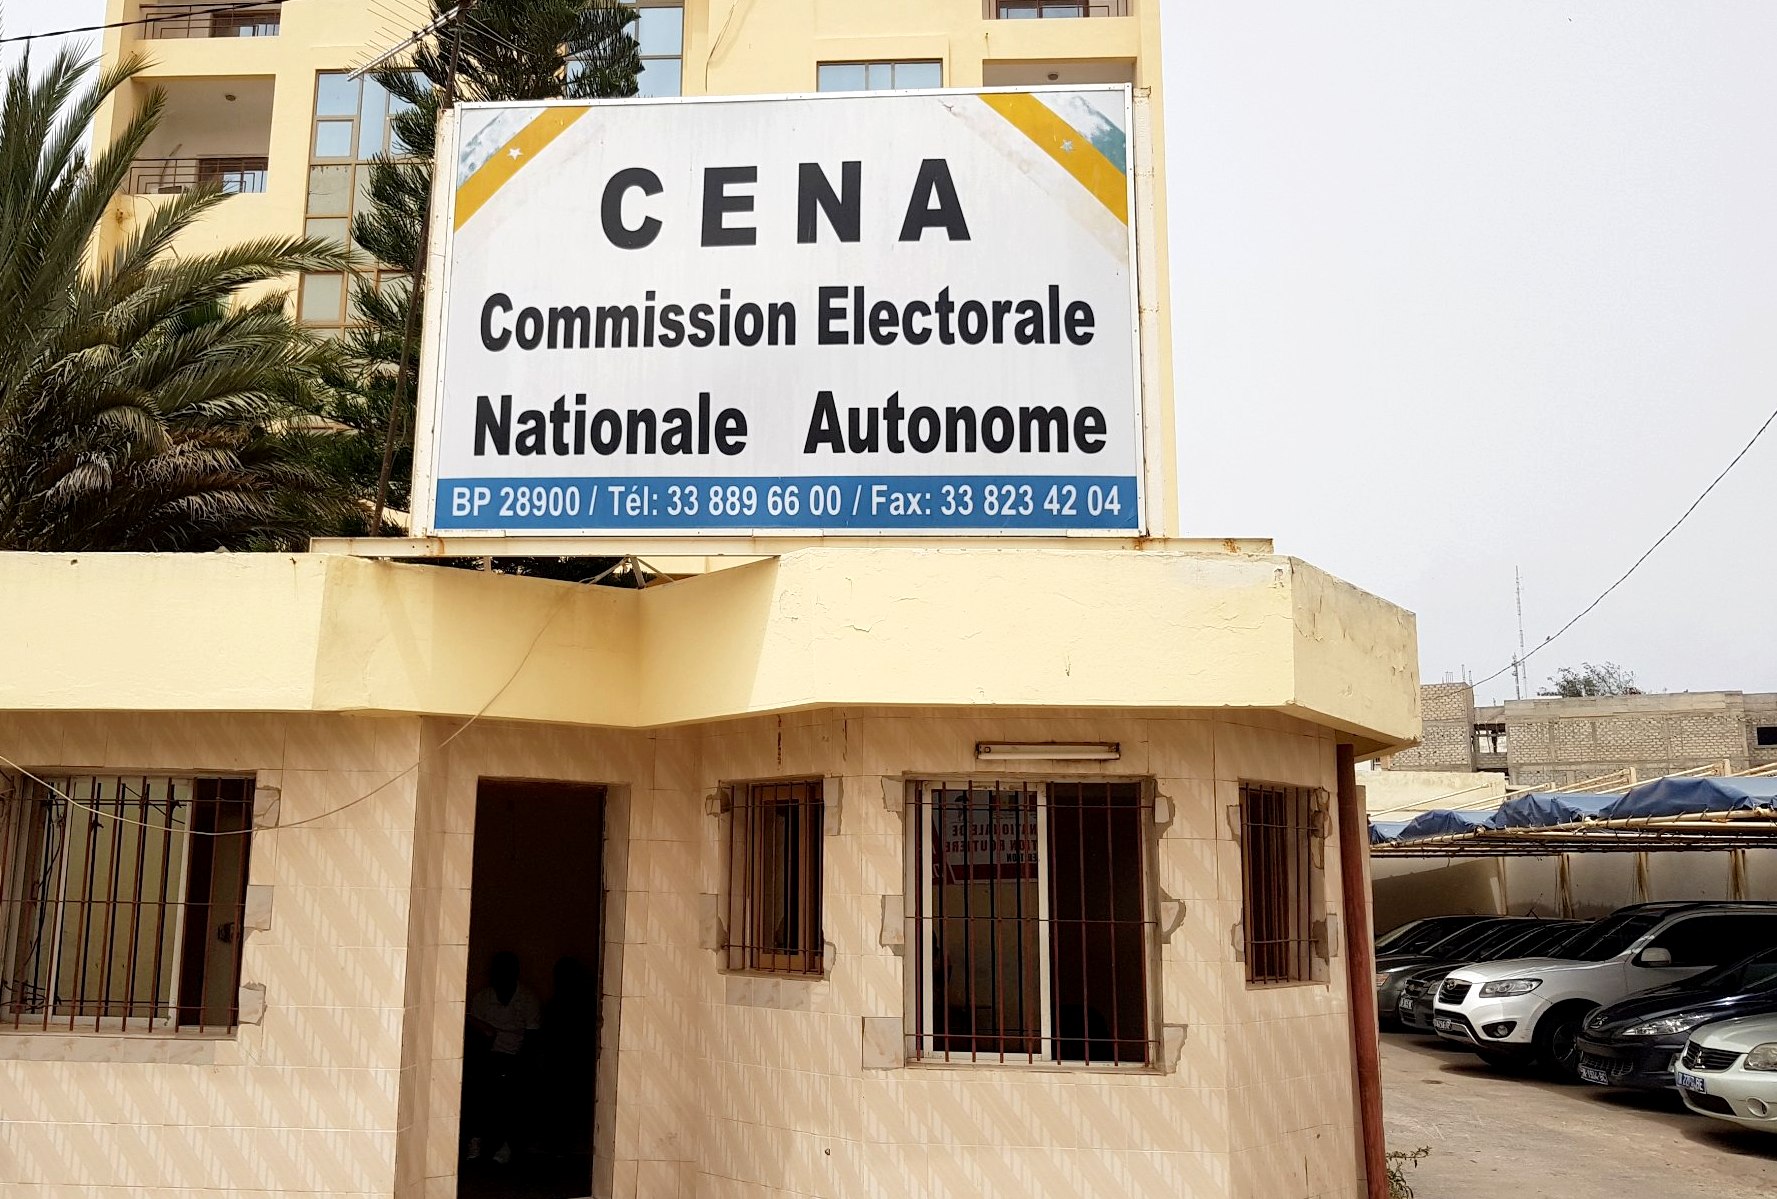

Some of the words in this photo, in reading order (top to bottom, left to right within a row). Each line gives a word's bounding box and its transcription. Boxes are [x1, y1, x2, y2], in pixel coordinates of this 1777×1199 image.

[601, 159, 971, 249] CENA
[481, 289, 796, 351] Commission
[819, 285, 1095, 346] Electorale
[474, 392, 748, 457] Nationale
[804, 391, 1107, 454] Autonome
[453, 487, 491, 517] BP
[499, 486, 580, 517] 28900
[588, 485, 598, 516] /
[608, 485, 658, 516] Tél:
[667, 486, 699, 516] 33
[709, 485, 758, 516] 889
[768, 485, 800, 516] 66
[810, 485, 842, 516] 00
[852, 485, 862, 516] /
[872, 485, 931, 515] Fax:
[941, 485, 974, 516] 33
[984, 485, 1034, 516] 823
[1044, 485, 1077, 516] 42
[1087, 485, 1121, 516] 04
